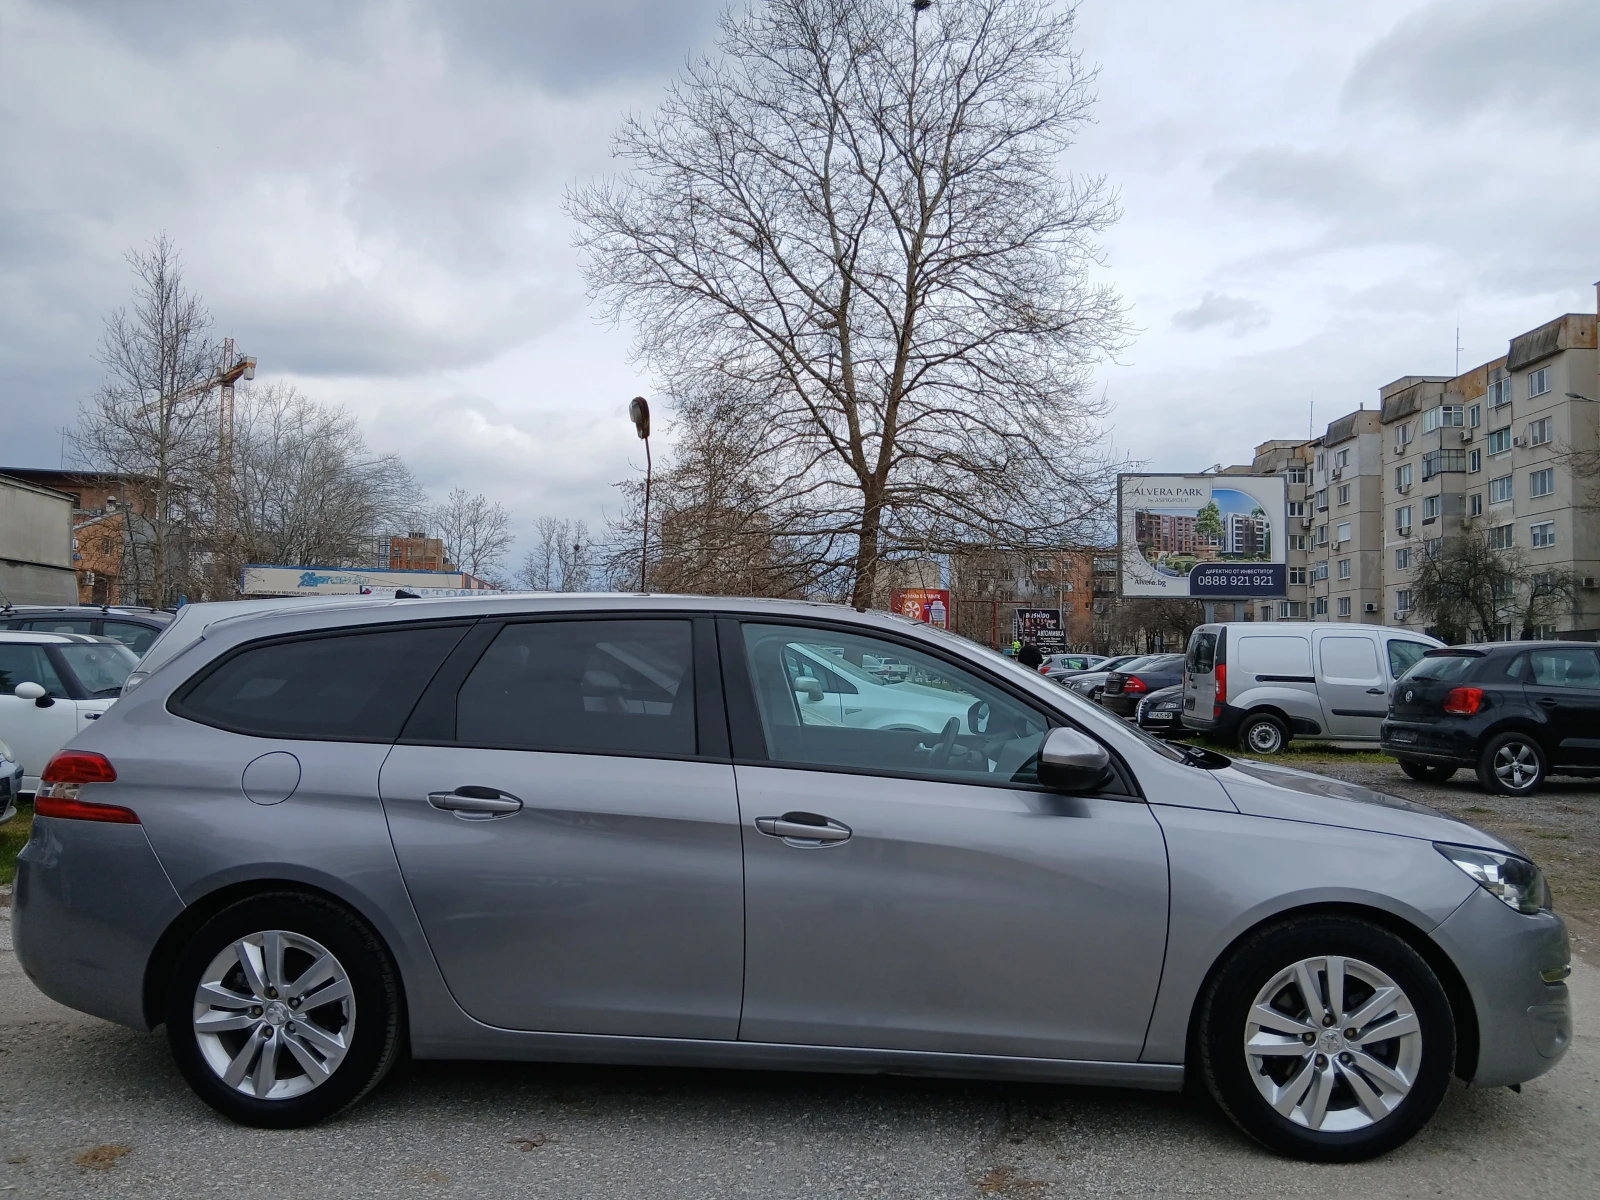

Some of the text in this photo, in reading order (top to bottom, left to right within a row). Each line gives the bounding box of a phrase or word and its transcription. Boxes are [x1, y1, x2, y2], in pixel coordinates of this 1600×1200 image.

[1134, 487, 1203, 496] ALVERA PARK
[1134, 579, 1167, 587] Alvera.bg
[1198, 575, 1274, 586] 0888 921 921
